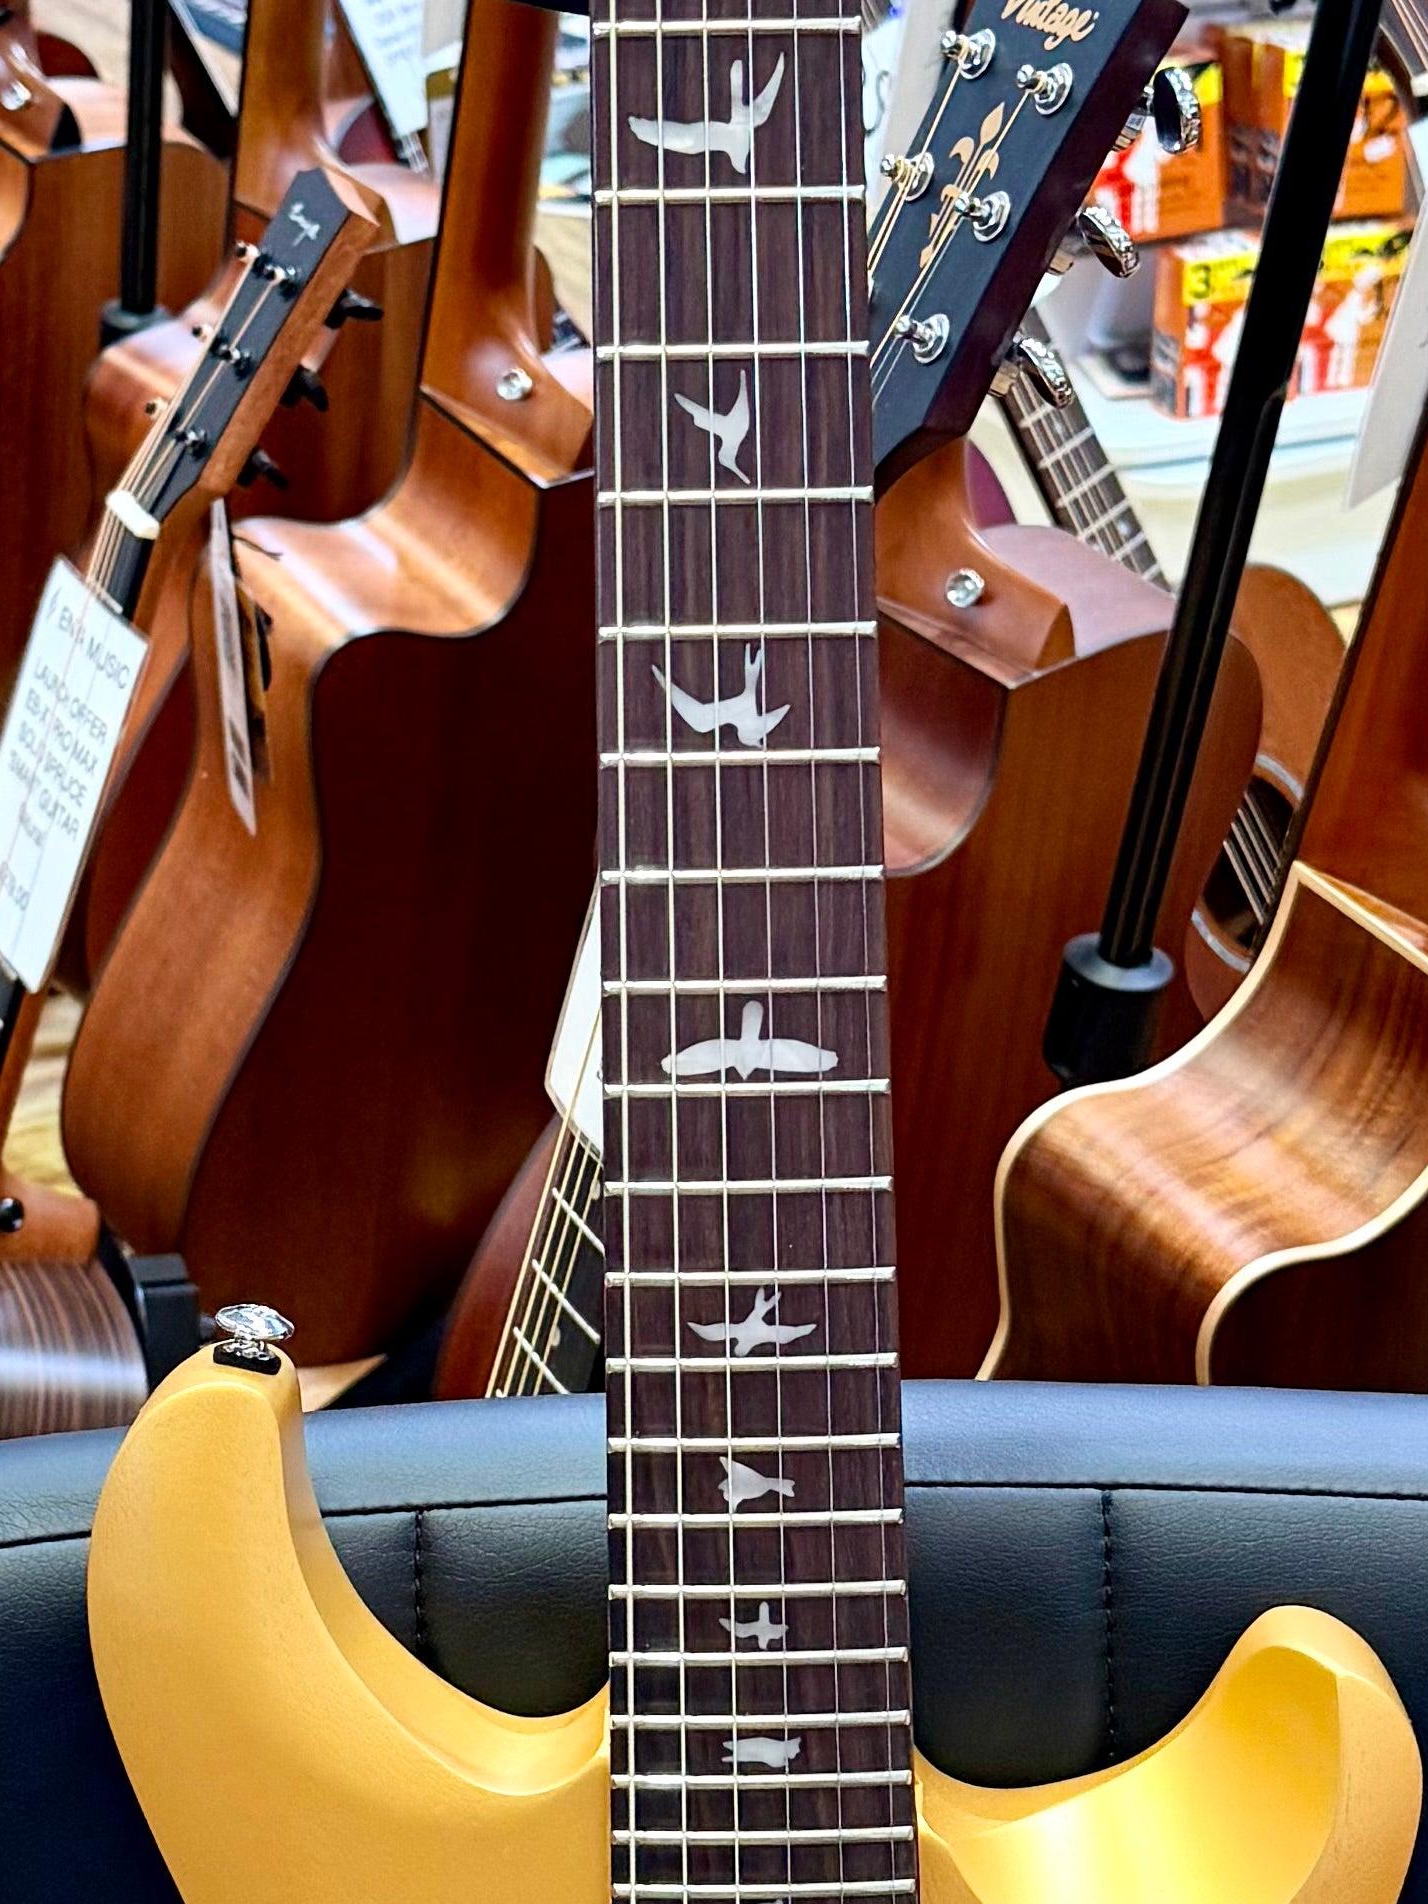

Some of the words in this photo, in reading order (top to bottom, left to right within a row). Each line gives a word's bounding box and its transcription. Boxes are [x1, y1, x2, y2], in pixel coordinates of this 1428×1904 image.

[1190, 261, 1212, 300] 3
[85, 631, 131, 694] MUSIC
[68, 692, 109, 750] OFFER
[37, 783, 80, 846] GUITAR
